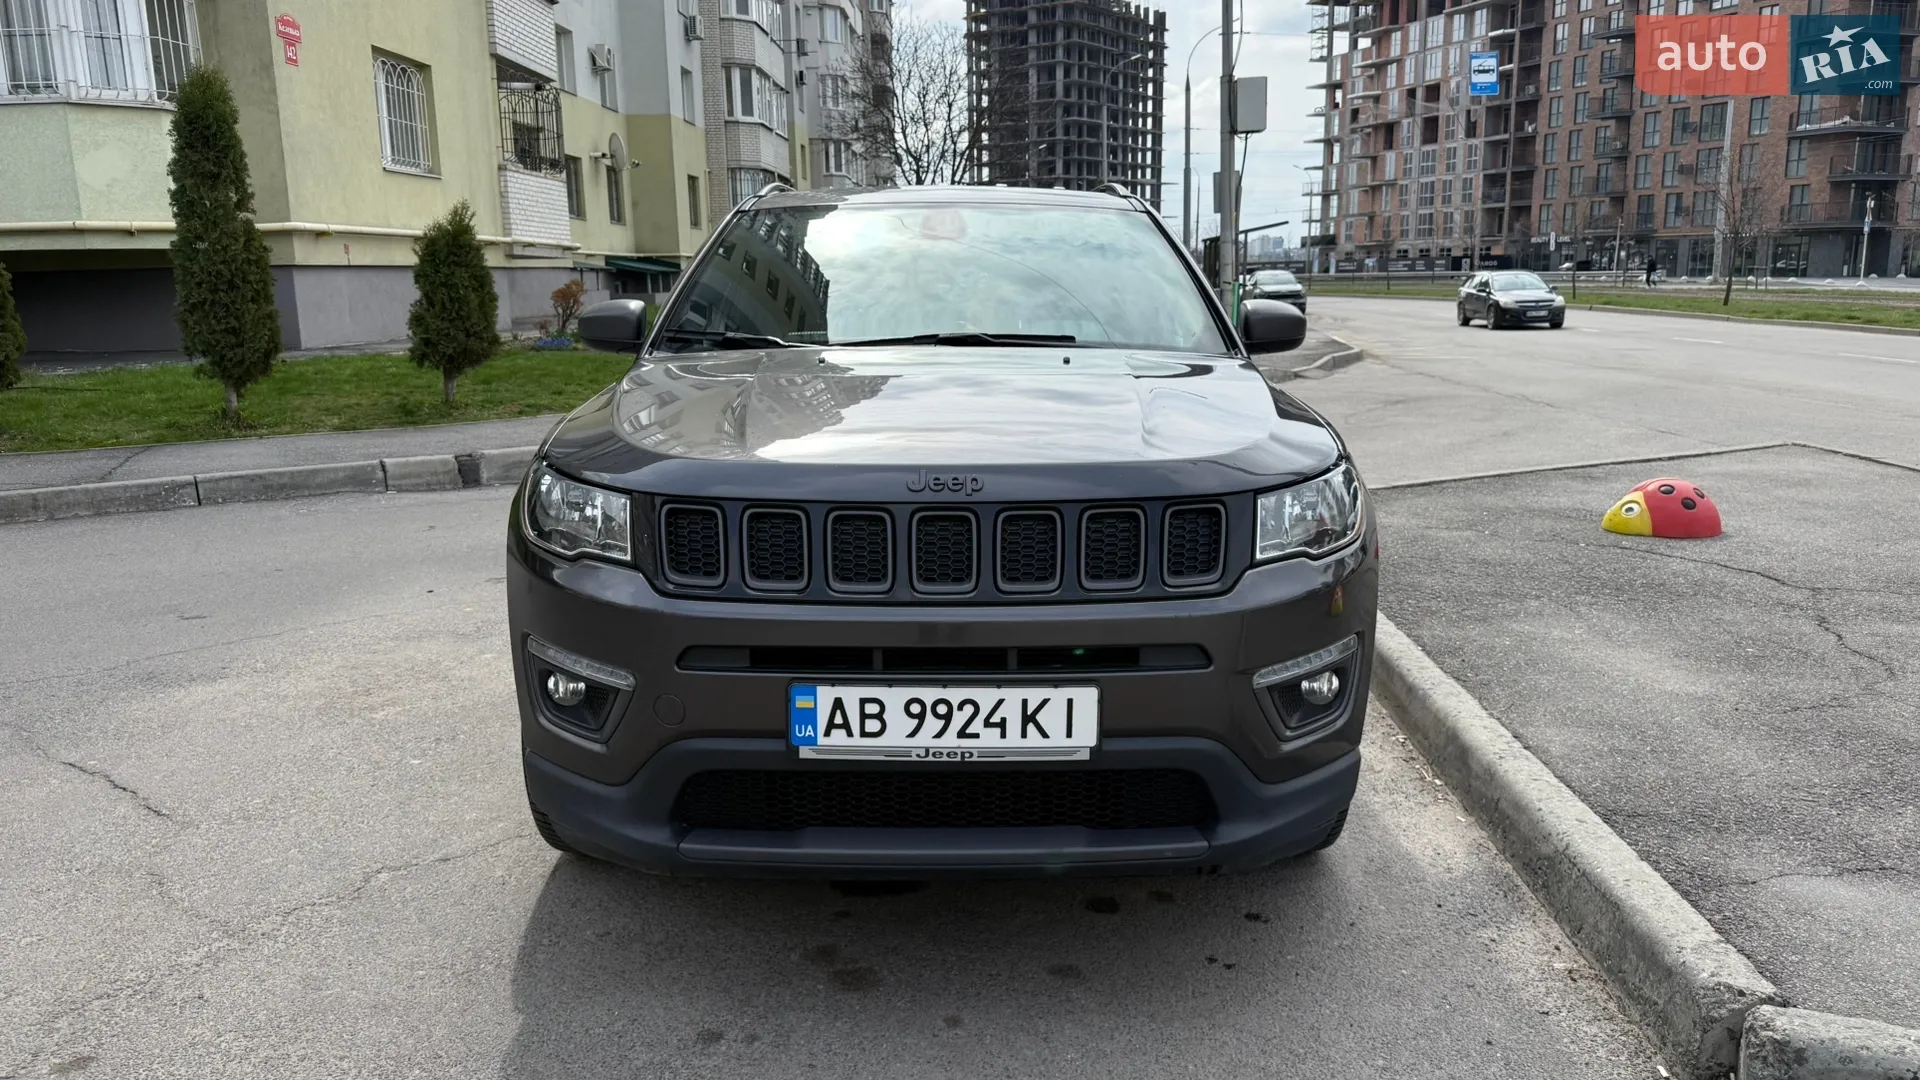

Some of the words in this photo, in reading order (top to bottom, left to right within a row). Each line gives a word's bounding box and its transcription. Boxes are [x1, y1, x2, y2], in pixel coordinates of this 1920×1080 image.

[286, 45, 297, 60] 142
[905, 470, 984, 496] Jeep
[823, 697, 887, 738] AB
[903, 697, 1007, 739] 9924
[1020, 697, 1074, 739] KI
[795, 724, 815, 737] UA
[915, 748, 974, 763] Jeep
